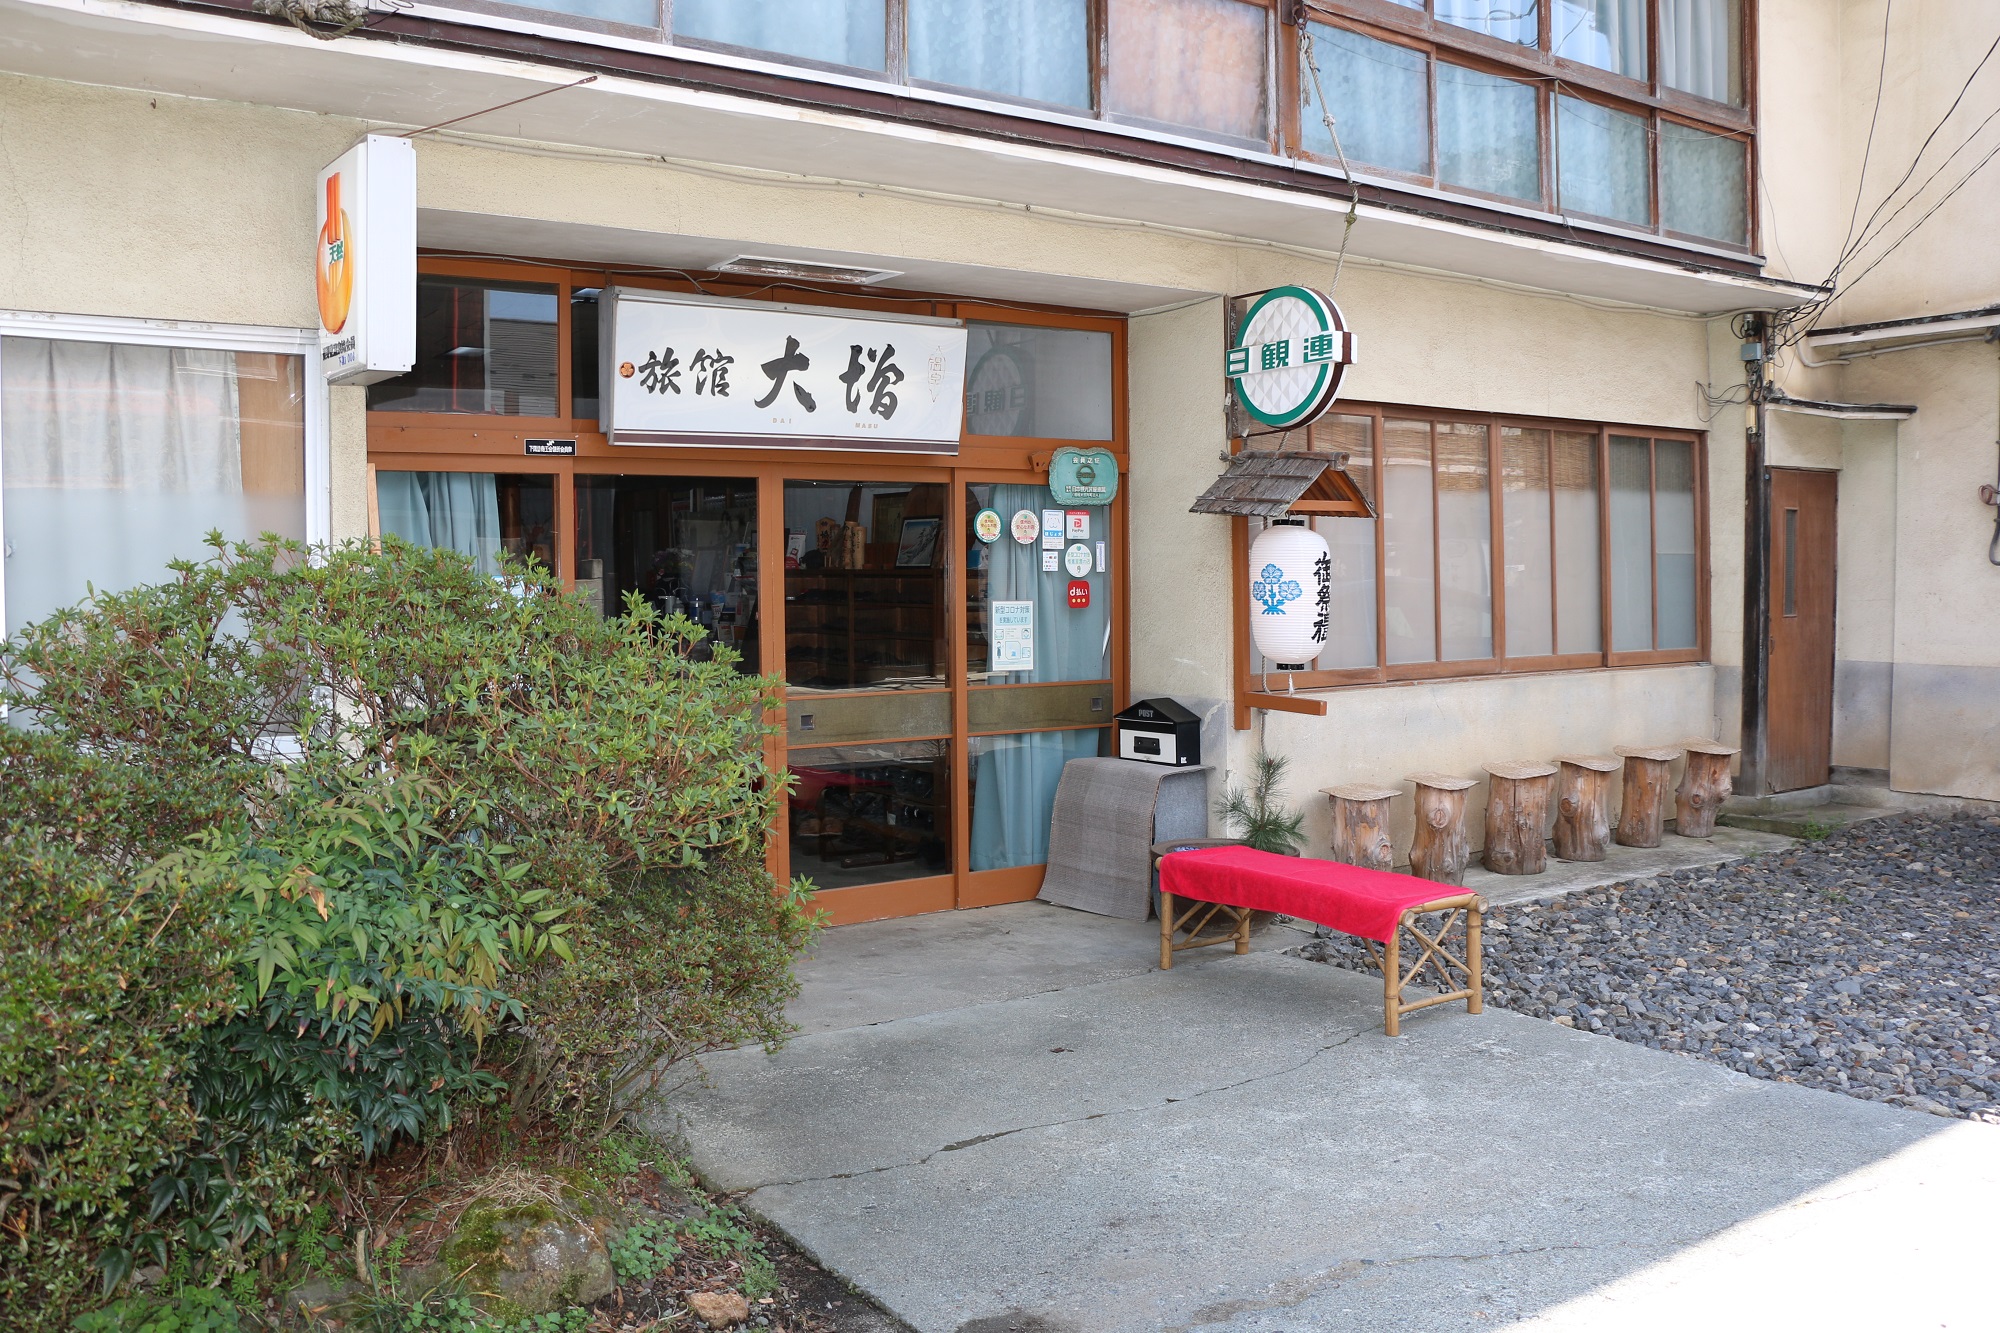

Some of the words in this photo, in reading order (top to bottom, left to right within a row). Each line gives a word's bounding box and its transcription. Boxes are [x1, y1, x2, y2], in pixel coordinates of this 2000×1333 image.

[1226, 334, 1333, 377] 日観連
[638, 347, 735, 397] 旅館
[773, 417, 793, 425] DAI
[855, 422, 879, 430] MASU
[1069, 586, 1088, 597] d払い
[995, 605, 1030, 615] 新型コロナ対策
[999, 616, 1028, 624] を実施しています
[1138, 709, 1154, 718] POST
